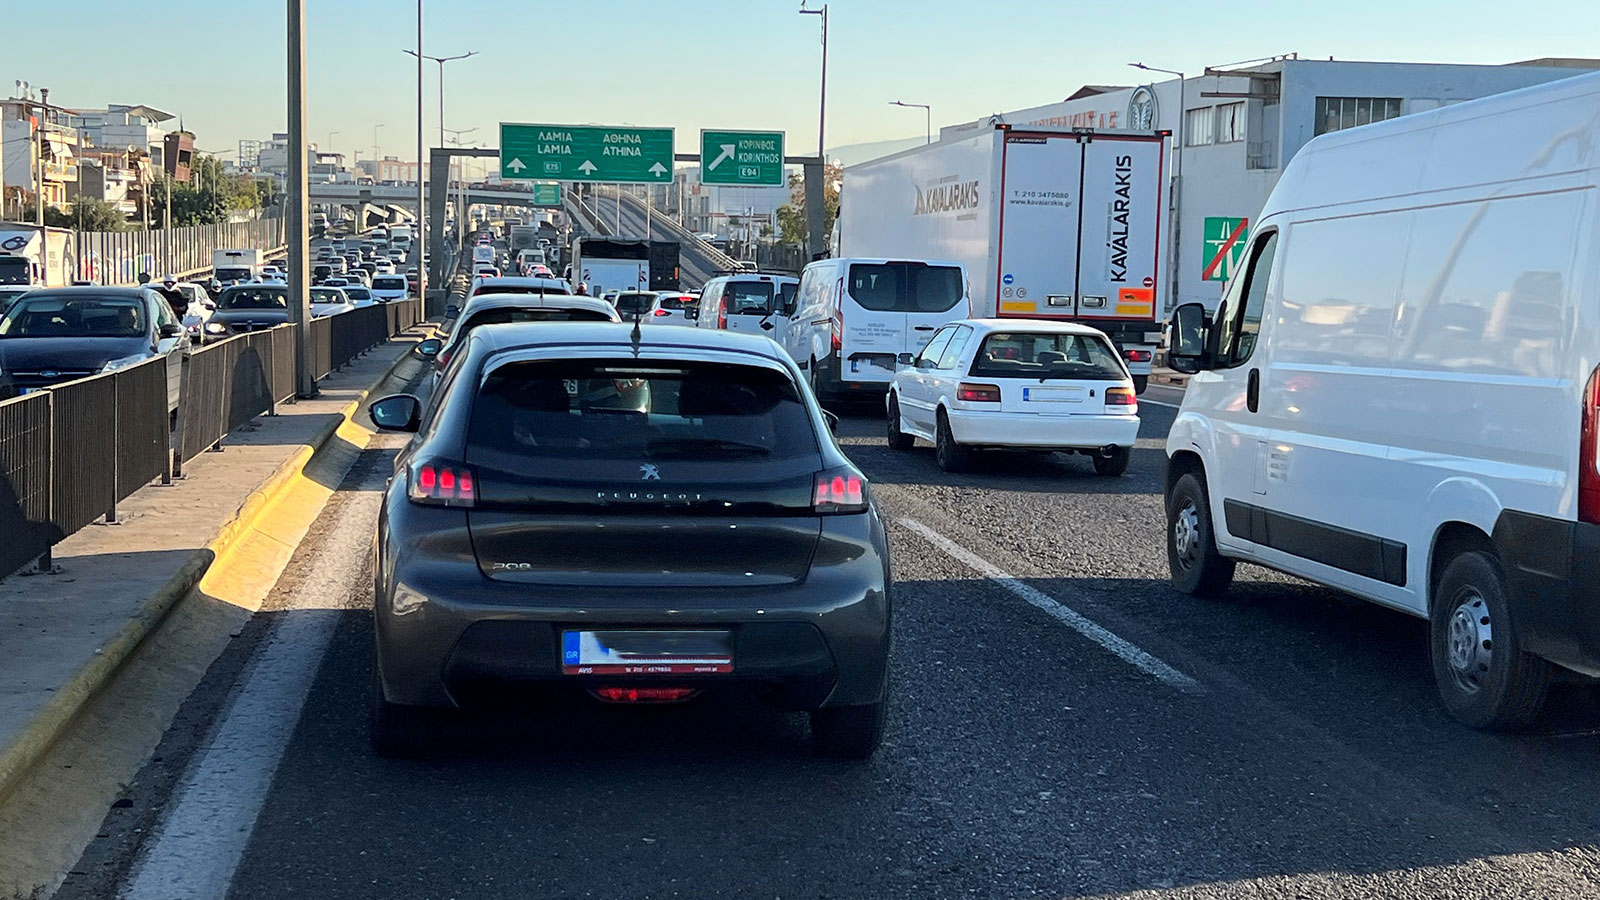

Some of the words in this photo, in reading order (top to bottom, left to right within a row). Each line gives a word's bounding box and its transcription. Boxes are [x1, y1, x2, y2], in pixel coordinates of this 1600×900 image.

[538, 131, 573, 142] ΛΑΜΙΑ
[603, 133, 642, 144] ΑΘΗΝΑ
[537, 144, 572, 155] LAMIA
[738, 139, 776, 151] ΚΟΡΙΝΘΟΣ
[602, 146, 642, 157] ATHINA
[738, 152, 780, 164] KORINTHOS
[545, 162, 560, 171] E75
[741, 167, 757, 177] E94
[597, 492, 703, 500] PEUGEOT
[492, 562, 532, 570] 208
[566, 651, 579, 659] GR
